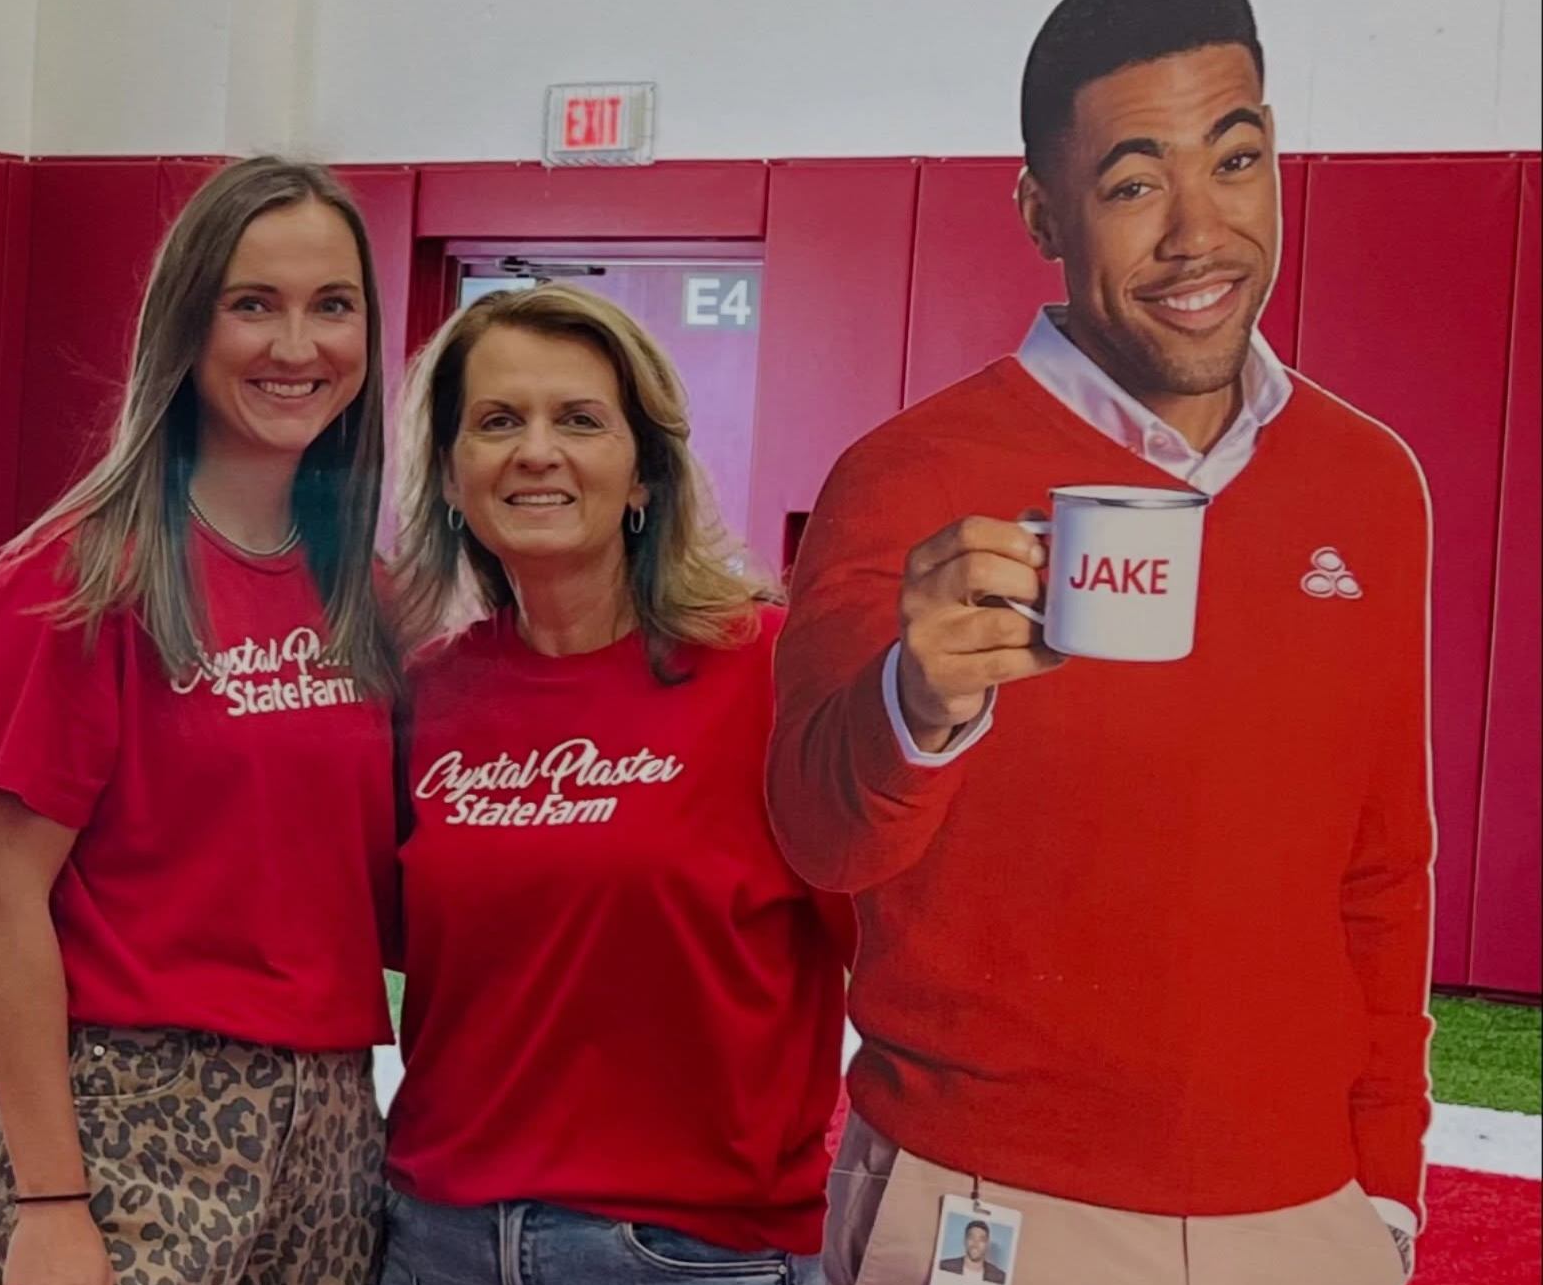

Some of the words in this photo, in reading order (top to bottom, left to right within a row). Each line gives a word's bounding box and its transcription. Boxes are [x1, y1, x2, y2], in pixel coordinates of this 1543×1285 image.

[564, 96, 622, 148] EXIT
[686, 277, 751, 326] E4
[1068, 553, 1170, 596] JAKE
[415, 748, 540, 803] Crystal
[540, 737, 684, 793] Plaster
